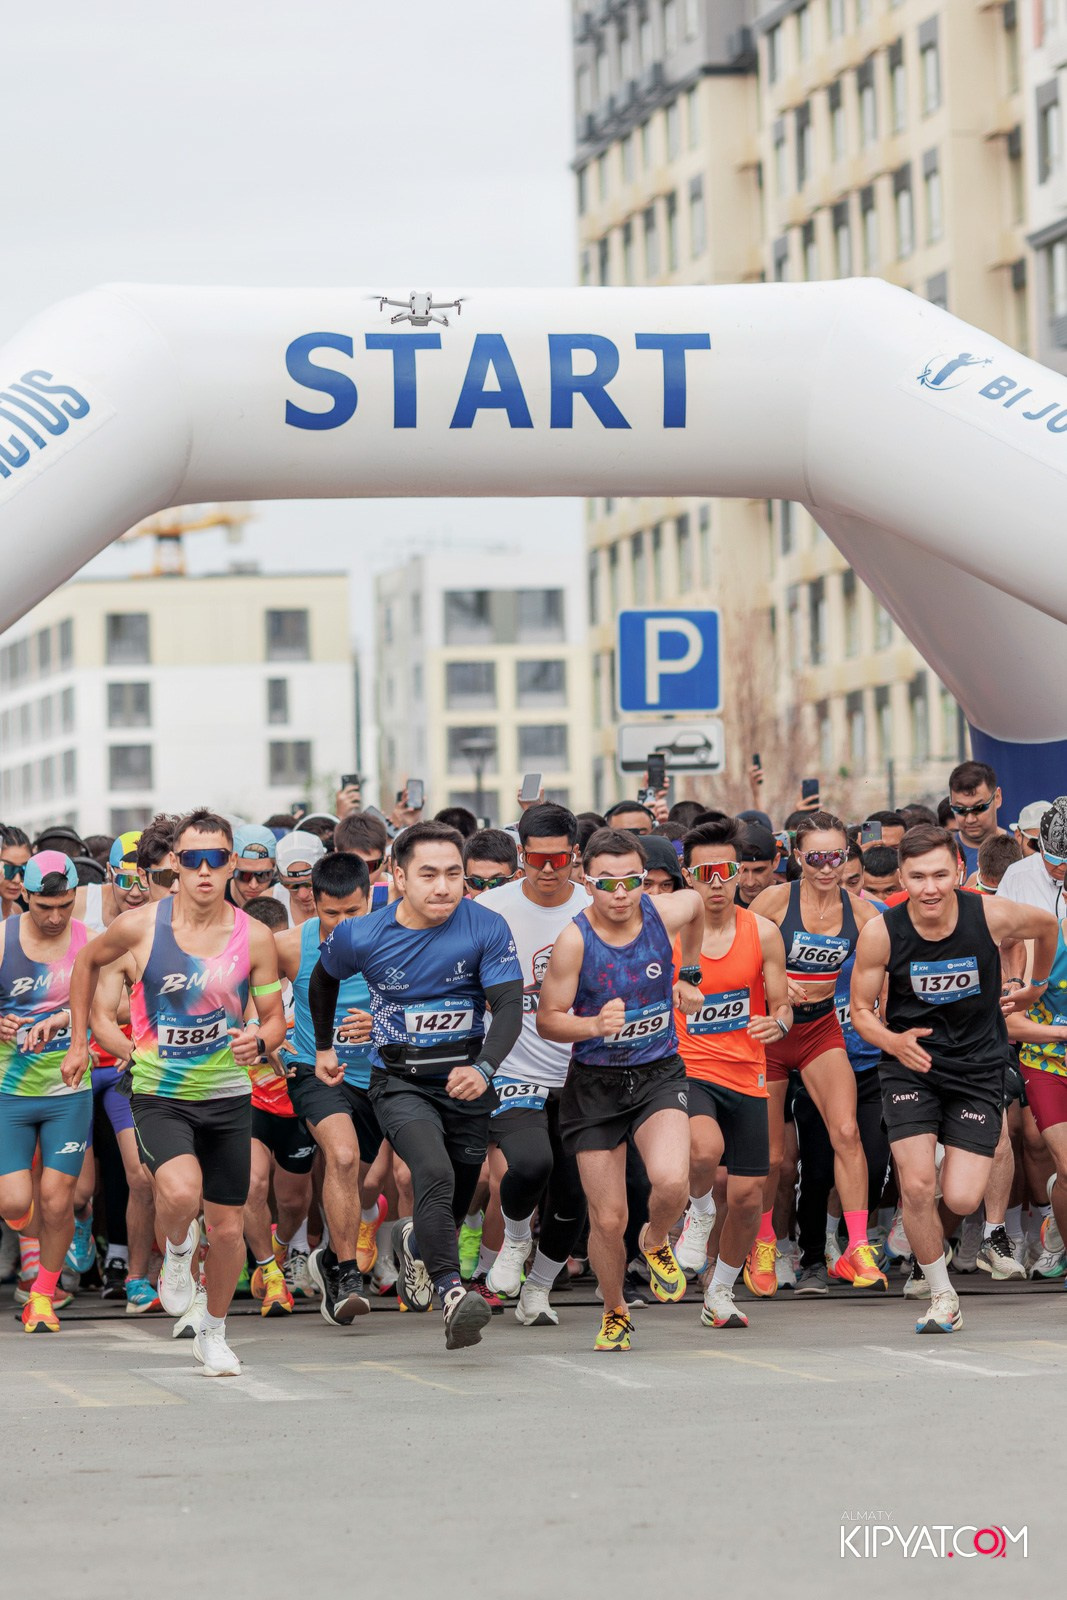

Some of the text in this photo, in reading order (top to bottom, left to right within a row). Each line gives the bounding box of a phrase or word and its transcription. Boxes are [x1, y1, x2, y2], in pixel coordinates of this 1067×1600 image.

[285, 331, 711, 431] START
[978, 375, 1033, 409] BI
[644, 617, 704, 705] P
[796, 946, 842, 963] 1666
[386, 983, 410, 991] GROUP
[920, 973, 971, 992] 1370
[415, 1012, 467, 1032] 1427
[166, 1023, 220, 1046] 1384
